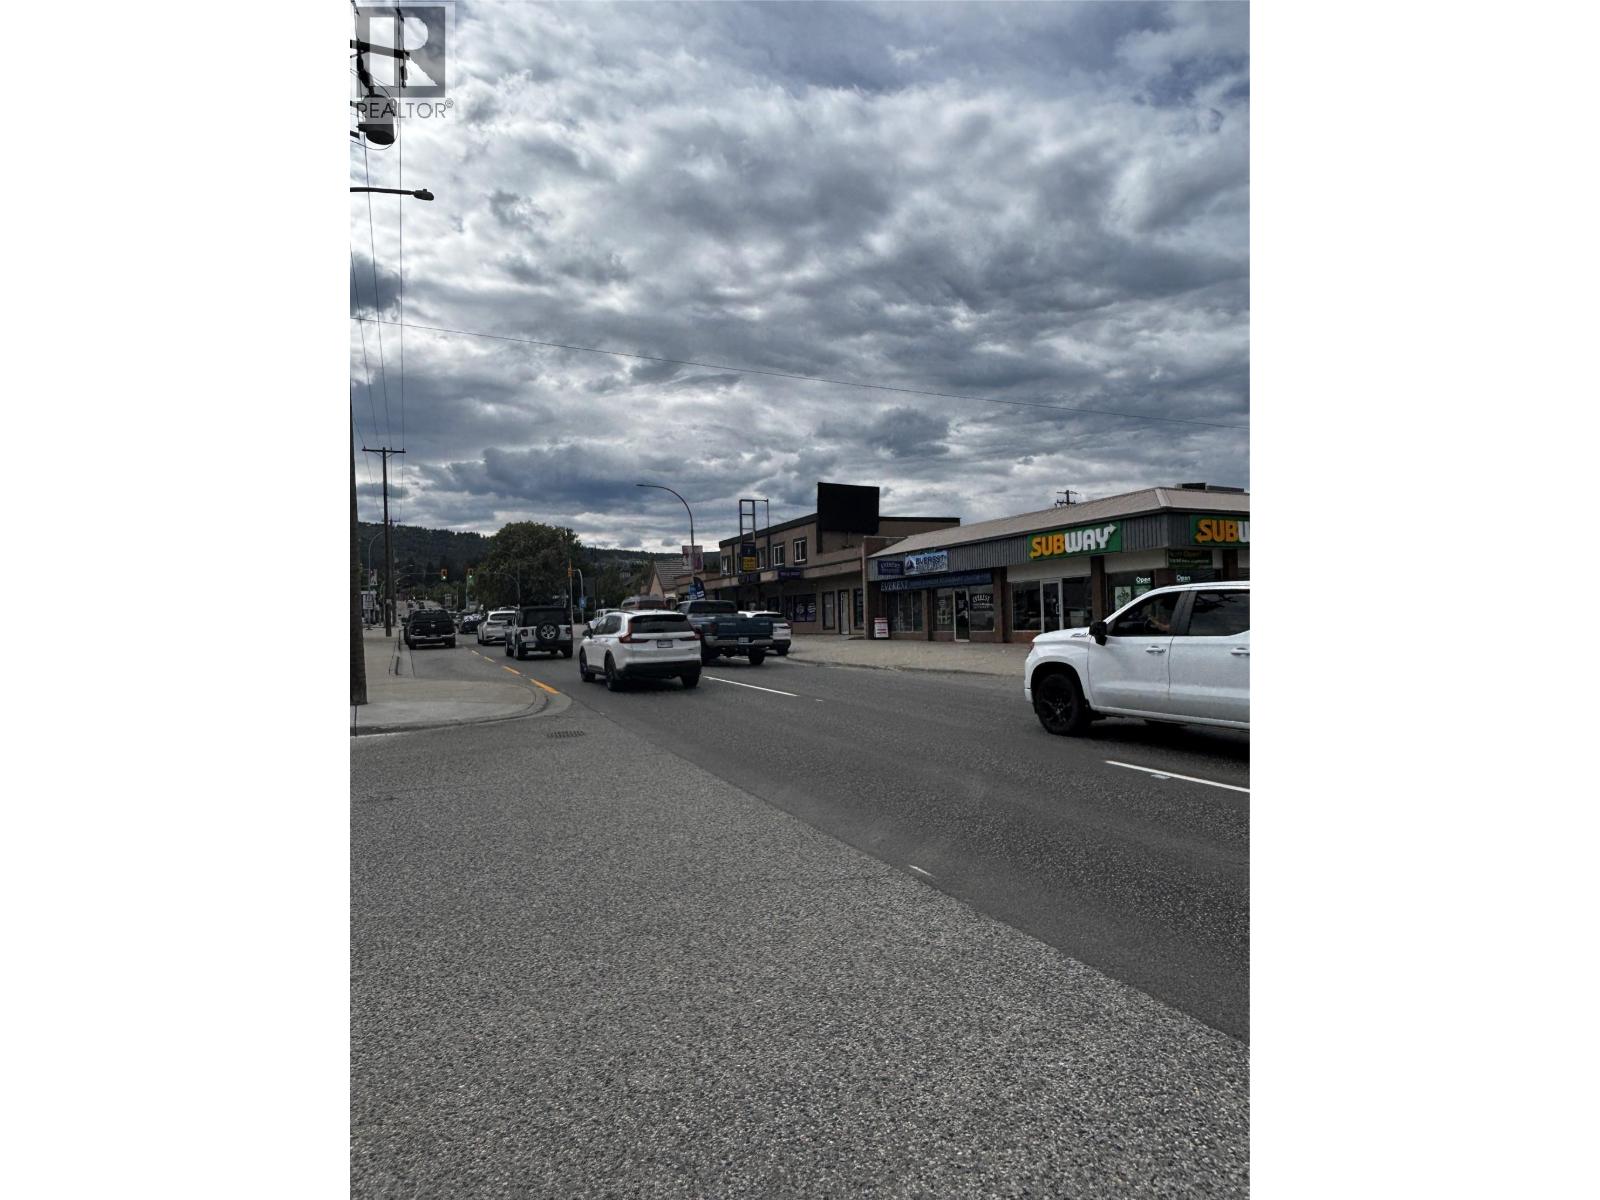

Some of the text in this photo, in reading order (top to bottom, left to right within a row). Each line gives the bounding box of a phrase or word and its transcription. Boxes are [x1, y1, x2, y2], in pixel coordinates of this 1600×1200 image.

[1029, 523, 1118, 559] SUBWAY
[916, 555, 945, 565] EVEREST
[1135, 576, 1151, 584] Open
